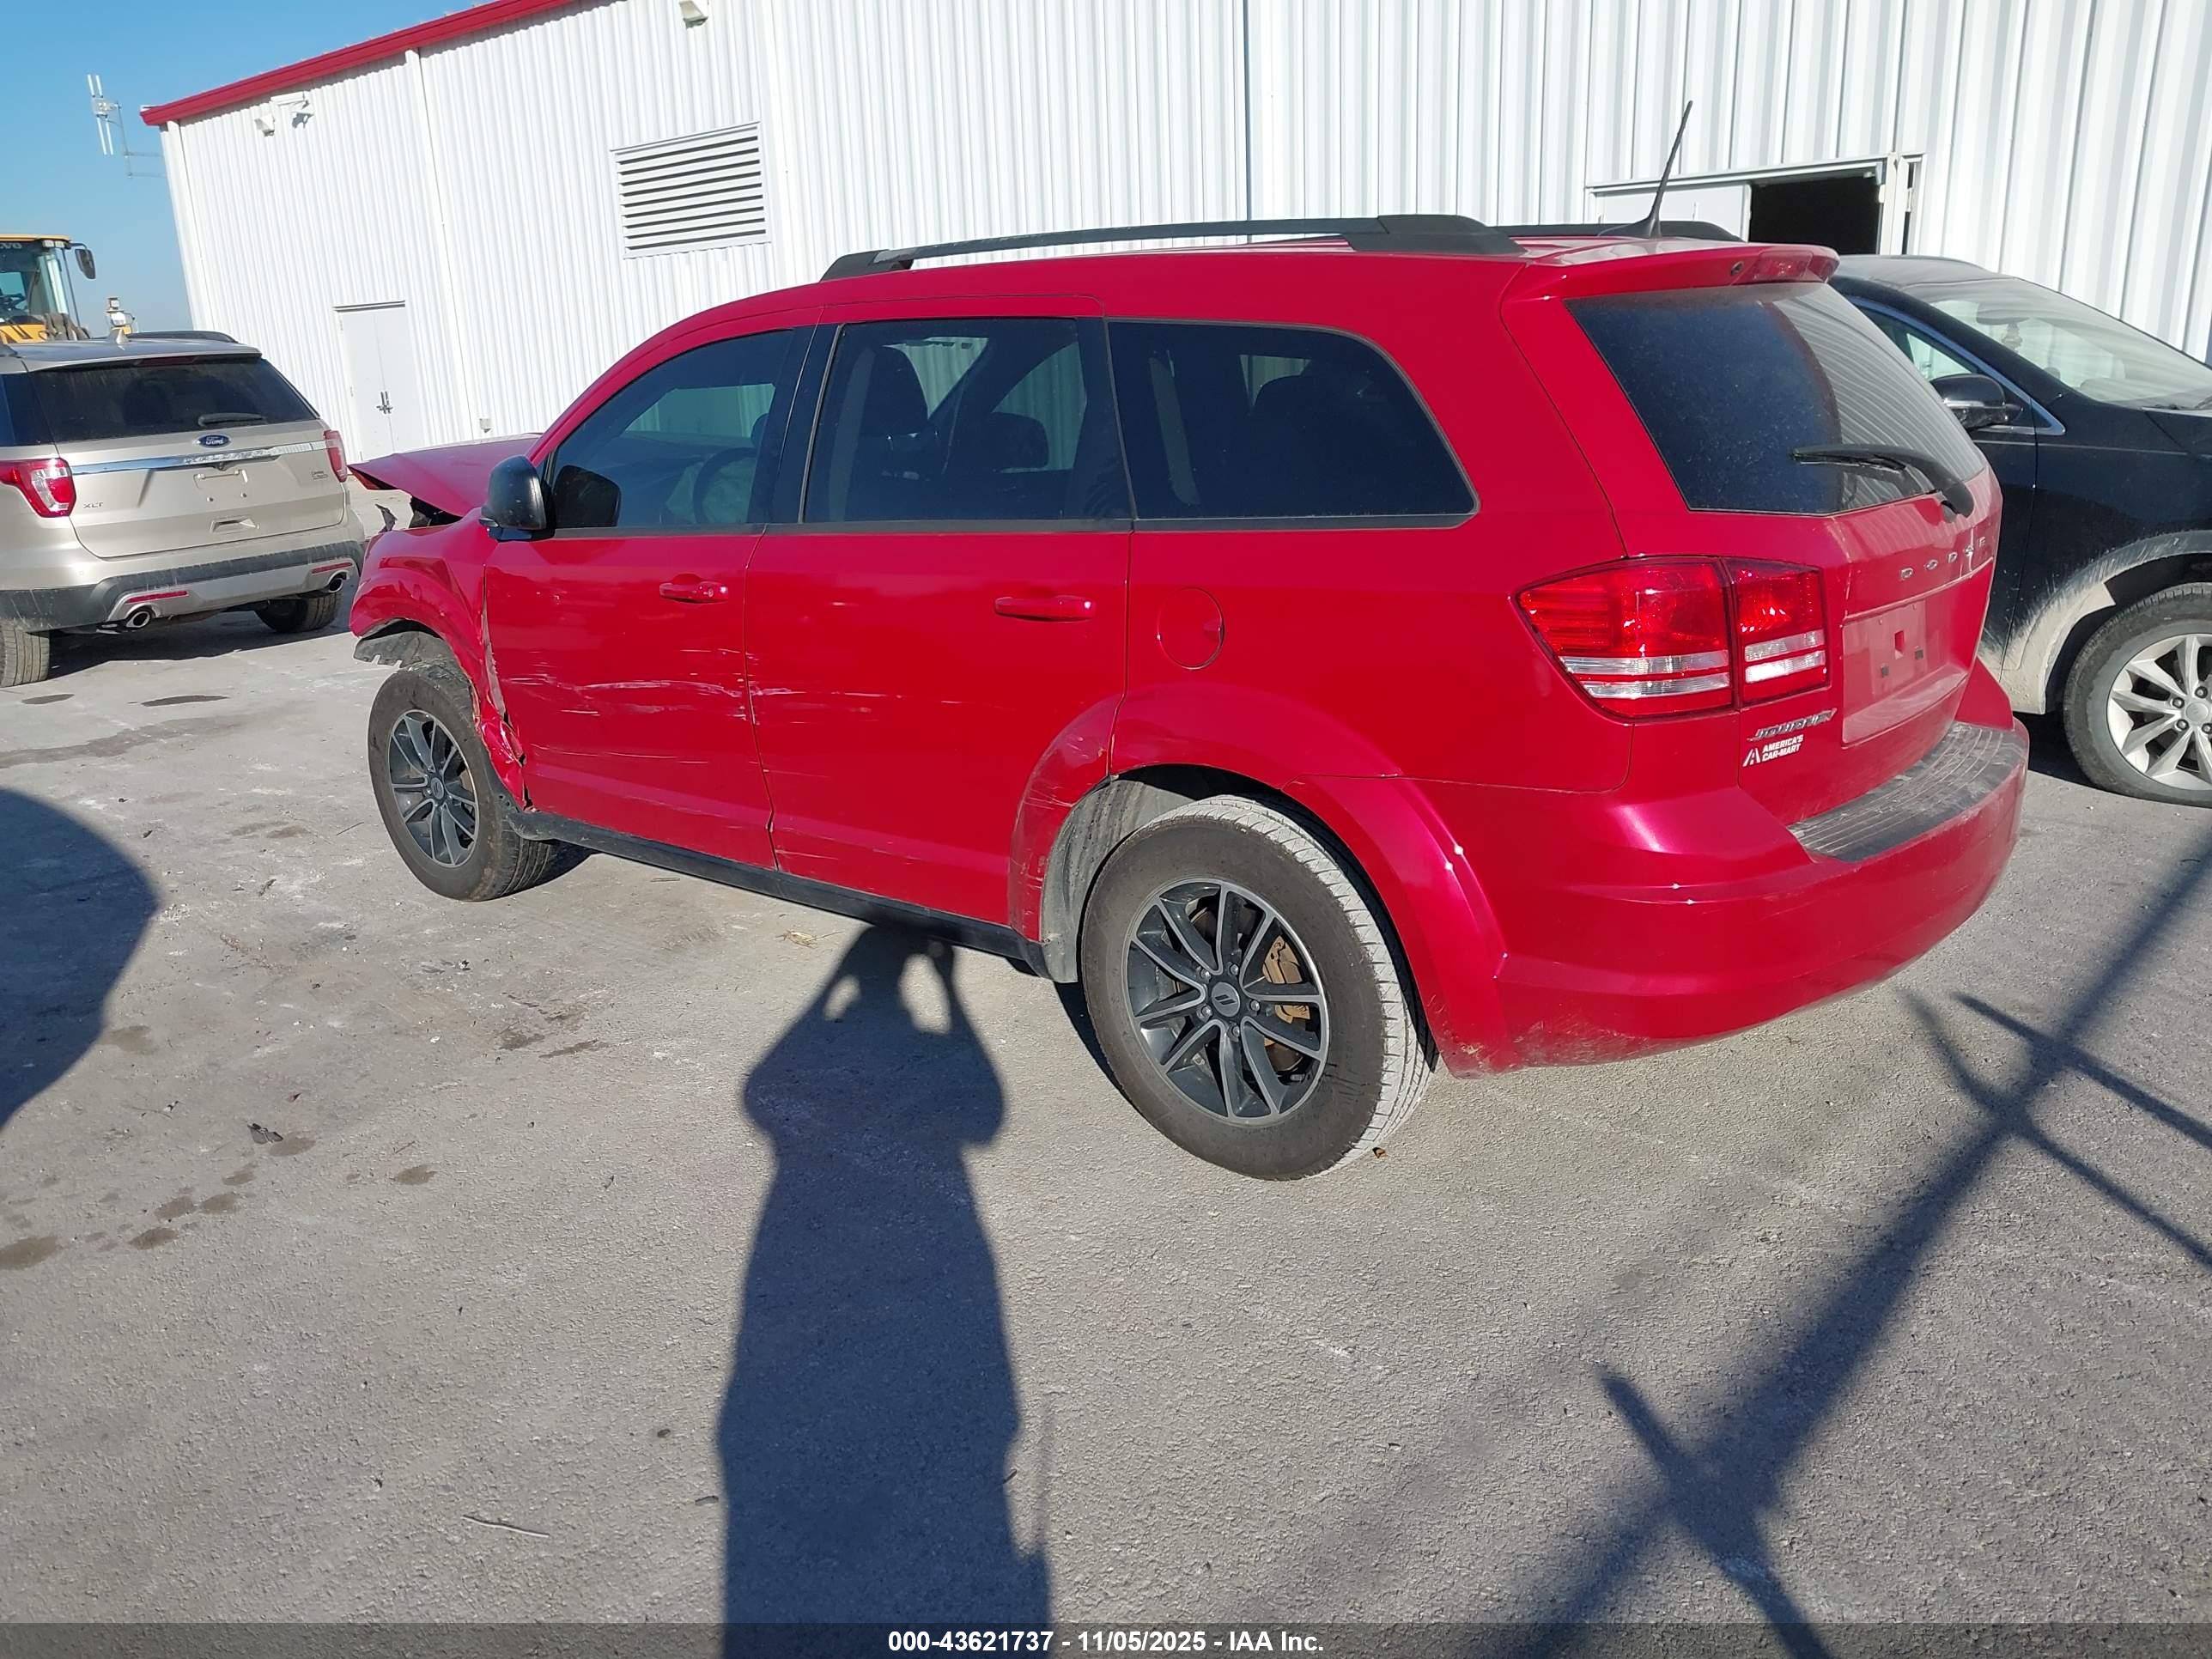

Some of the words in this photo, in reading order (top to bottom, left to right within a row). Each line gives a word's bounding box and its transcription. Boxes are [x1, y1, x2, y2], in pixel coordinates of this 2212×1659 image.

[1900, 537, 1986, 579] DODGE
[1762, 734, 1804, 754] AMERICA'S
[1762, 743, 1802, 763] CAR-MART
